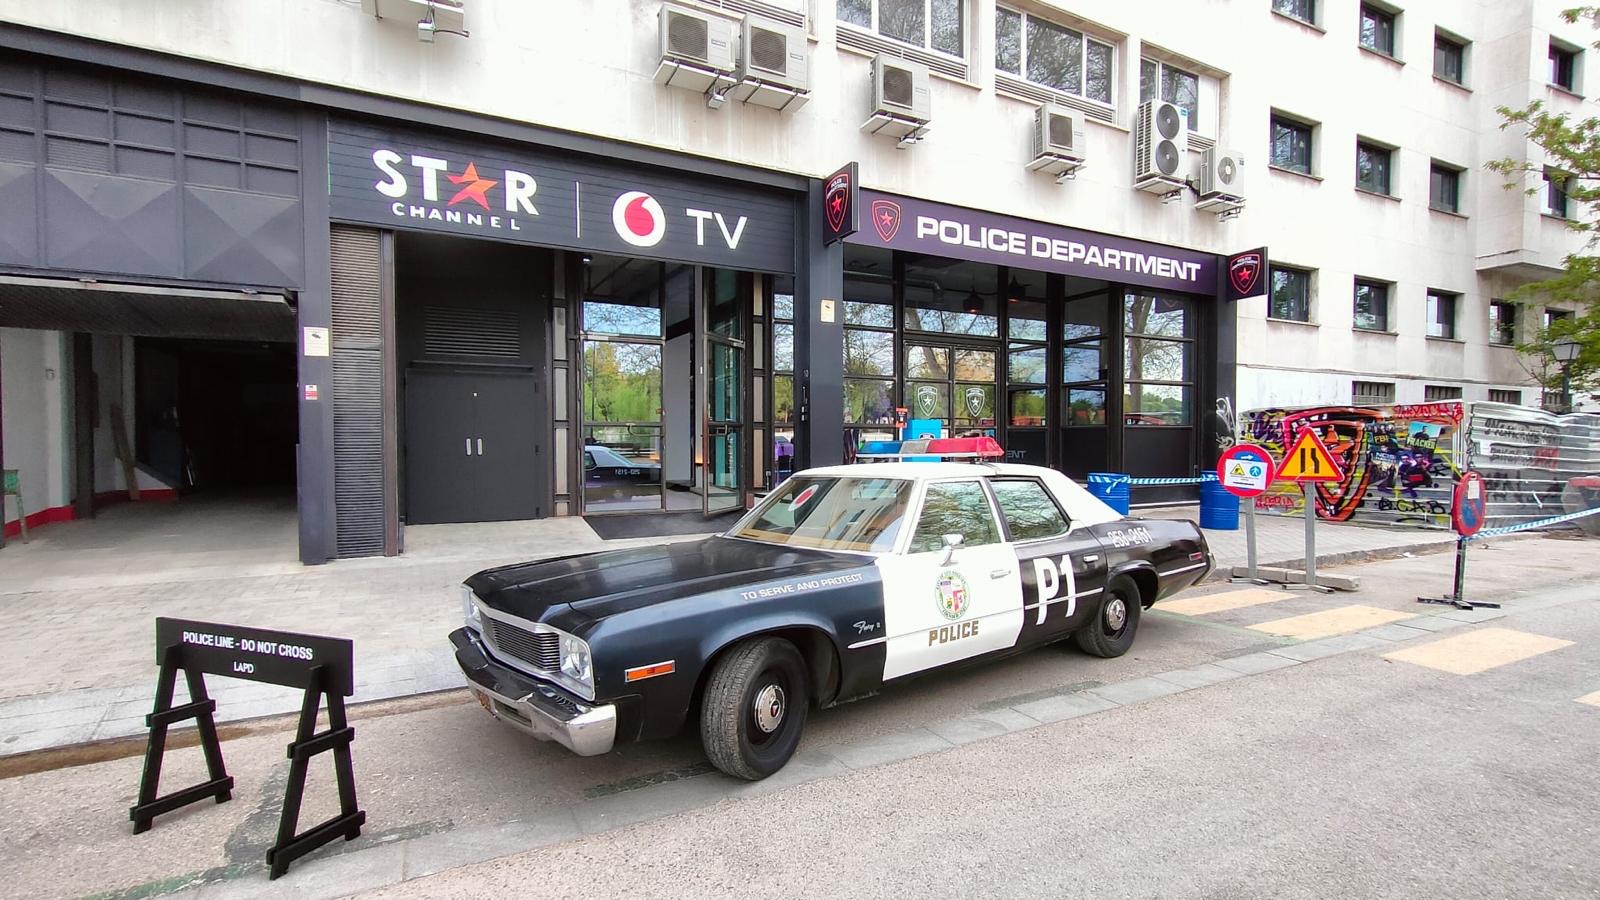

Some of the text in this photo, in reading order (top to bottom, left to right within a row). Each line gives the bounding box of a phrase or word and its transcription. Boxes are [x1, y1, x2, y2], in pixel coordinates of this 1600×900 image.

[391, 202, 521, 231] CHANNEL
[685, 208, 748, 249] TV
[917, 215, 1201, 282] POLICE DEPARTMENT
[740, 573, 863, 600] TO SERVE AND PROTECT
[1033, 553, 1076, 626] P1
[183, 631, 214, 647] POLICE
[214, 636, 234, 649] LINE
[241, 638, 256, 652] DO
[256, 640, 278, 655] NOT
[278, 644, 313, 660] CROSS
[928, 620, 979, 648] POLICE
[233, 661, 254, 674] LAPD
